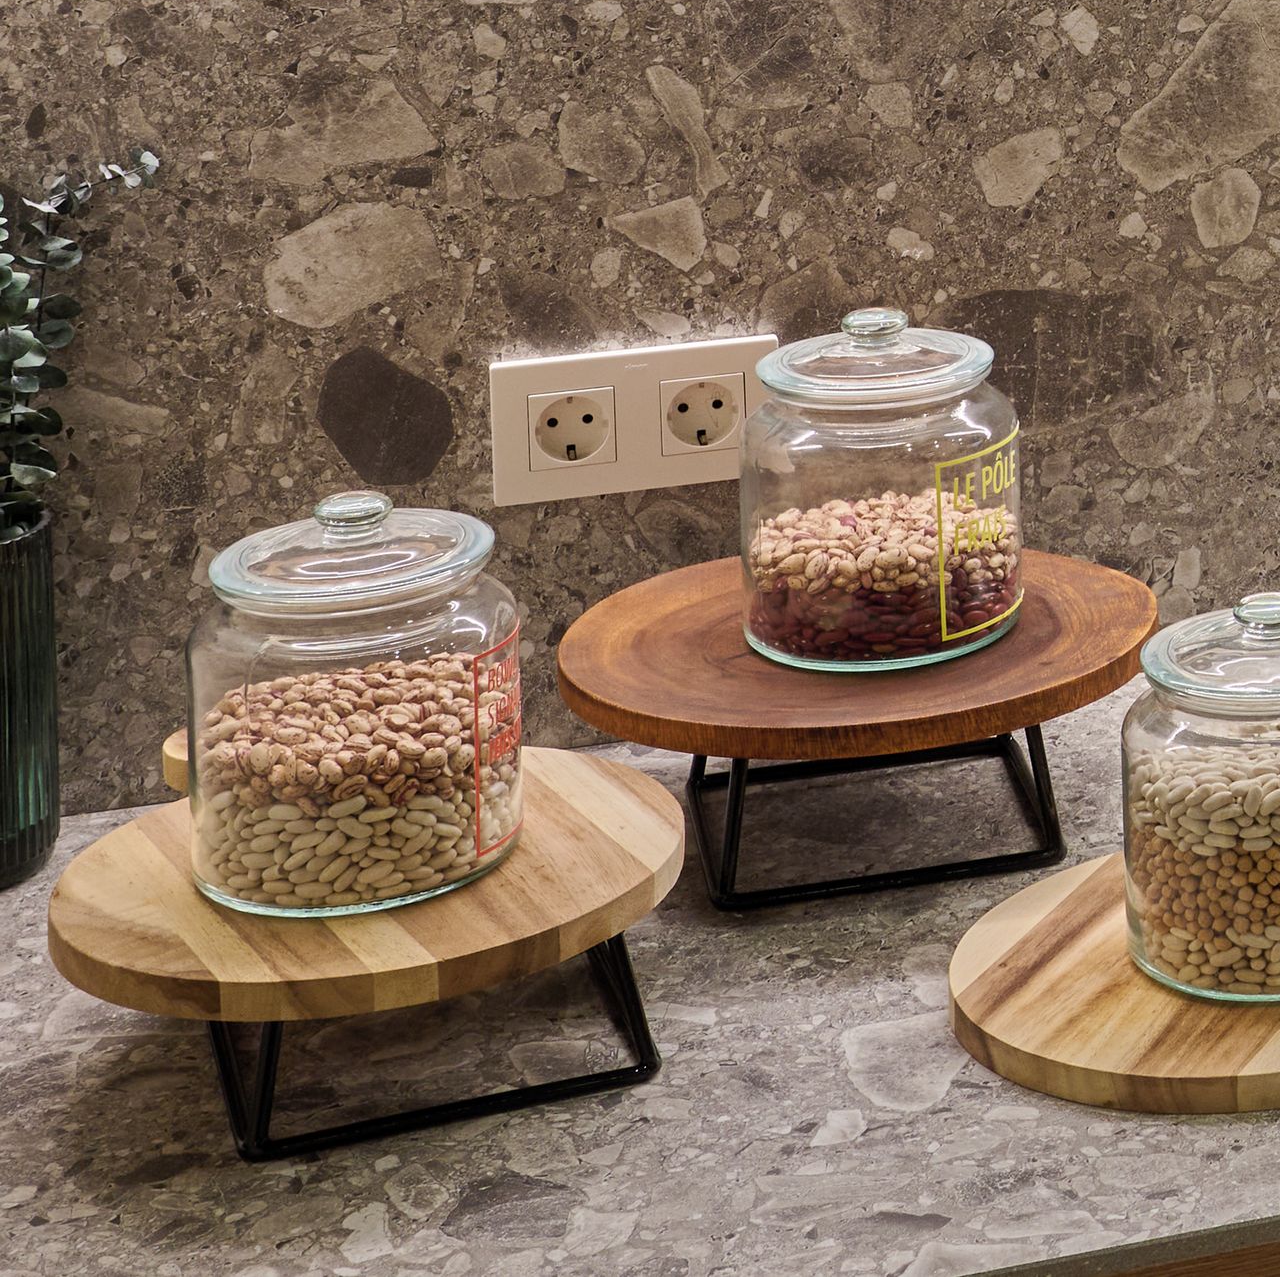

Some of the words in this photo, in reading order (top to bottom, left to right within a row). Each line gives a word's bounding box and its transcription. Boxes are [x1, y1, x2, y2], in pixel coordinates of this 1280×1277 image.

[953, 471, 976, 510] LE
[981, 450, 1016, 501] PÔLE
[954, 504, 1007, 556] FRAIS
